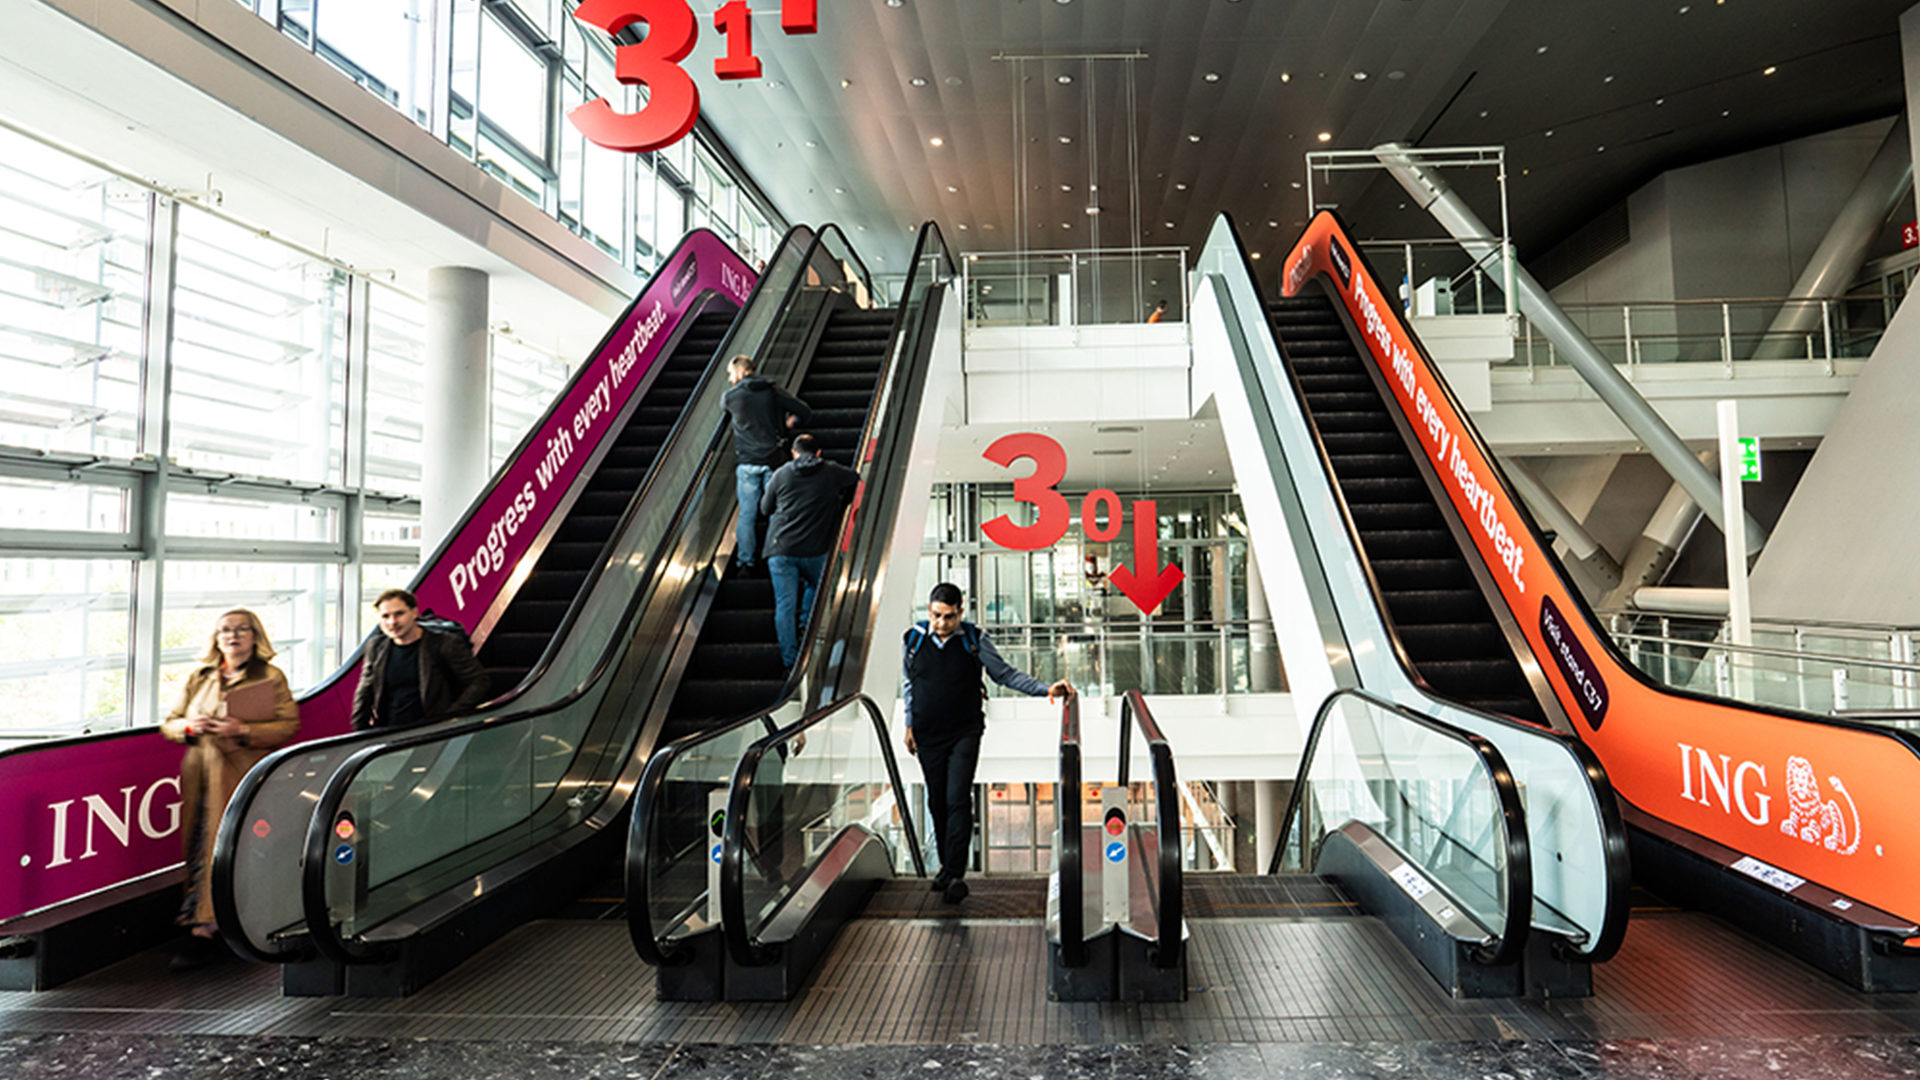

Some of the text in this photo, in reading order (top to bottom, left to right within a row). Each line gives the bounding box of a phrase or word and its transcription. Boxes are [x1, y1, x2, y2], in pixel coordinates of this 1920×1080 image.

[1354, 272, 1526, 594] Progress with every heartbeat.
[449, 481, 537, 611] Progress
[535, 426, 574, 490] with
[573, 375, 611, 440] every
[1560, 642, 1585, 685] stand
[1583, 679, 1602, 711] C37
[45, 775, 184, 869] ING
[1677, 742, 1772, 826] ING
